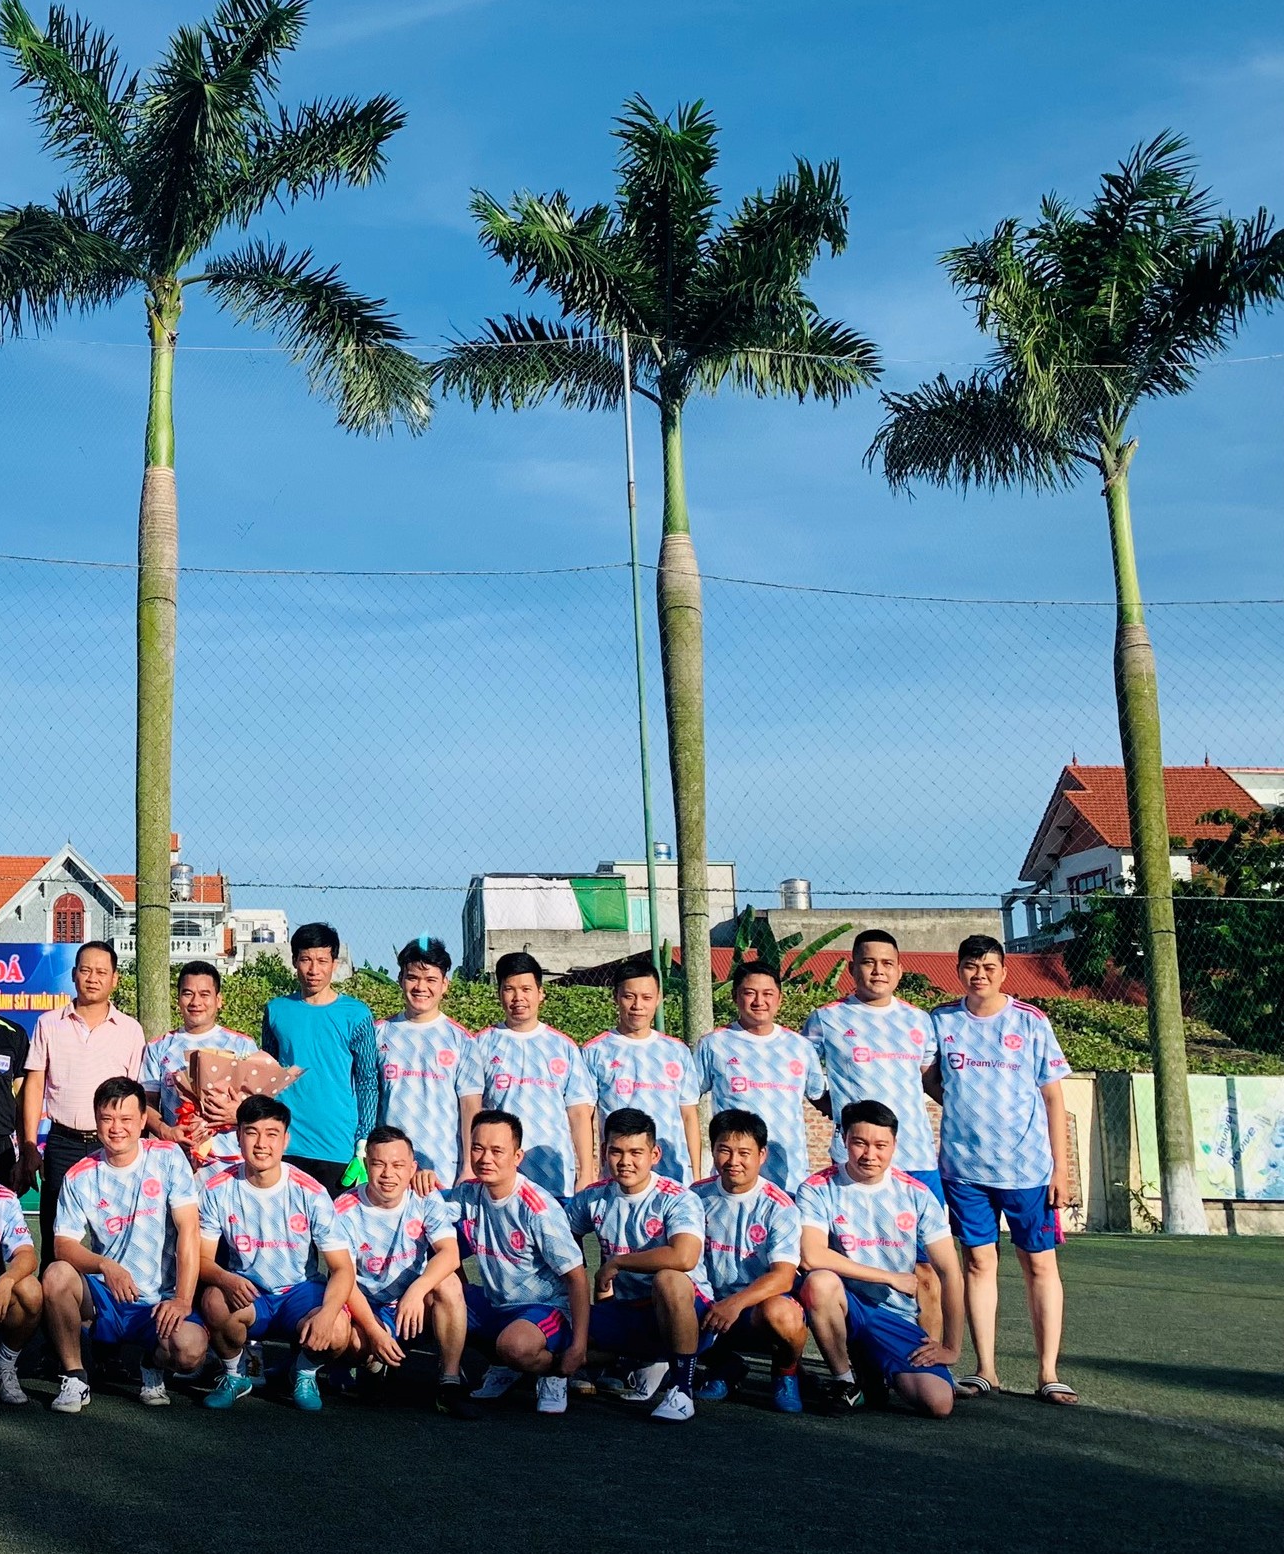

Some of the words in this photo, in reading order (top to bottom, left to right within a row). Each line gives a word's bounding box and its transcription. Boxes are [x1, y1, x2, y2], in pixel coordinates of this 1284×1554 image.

[14, 991, 29, 1010] SÁT
[30, 991, 53, 1010] NHÂN
[965, 1058, 1022, 1071] TeamViewer
[1228, 1126, 1257, 1169] Revive
